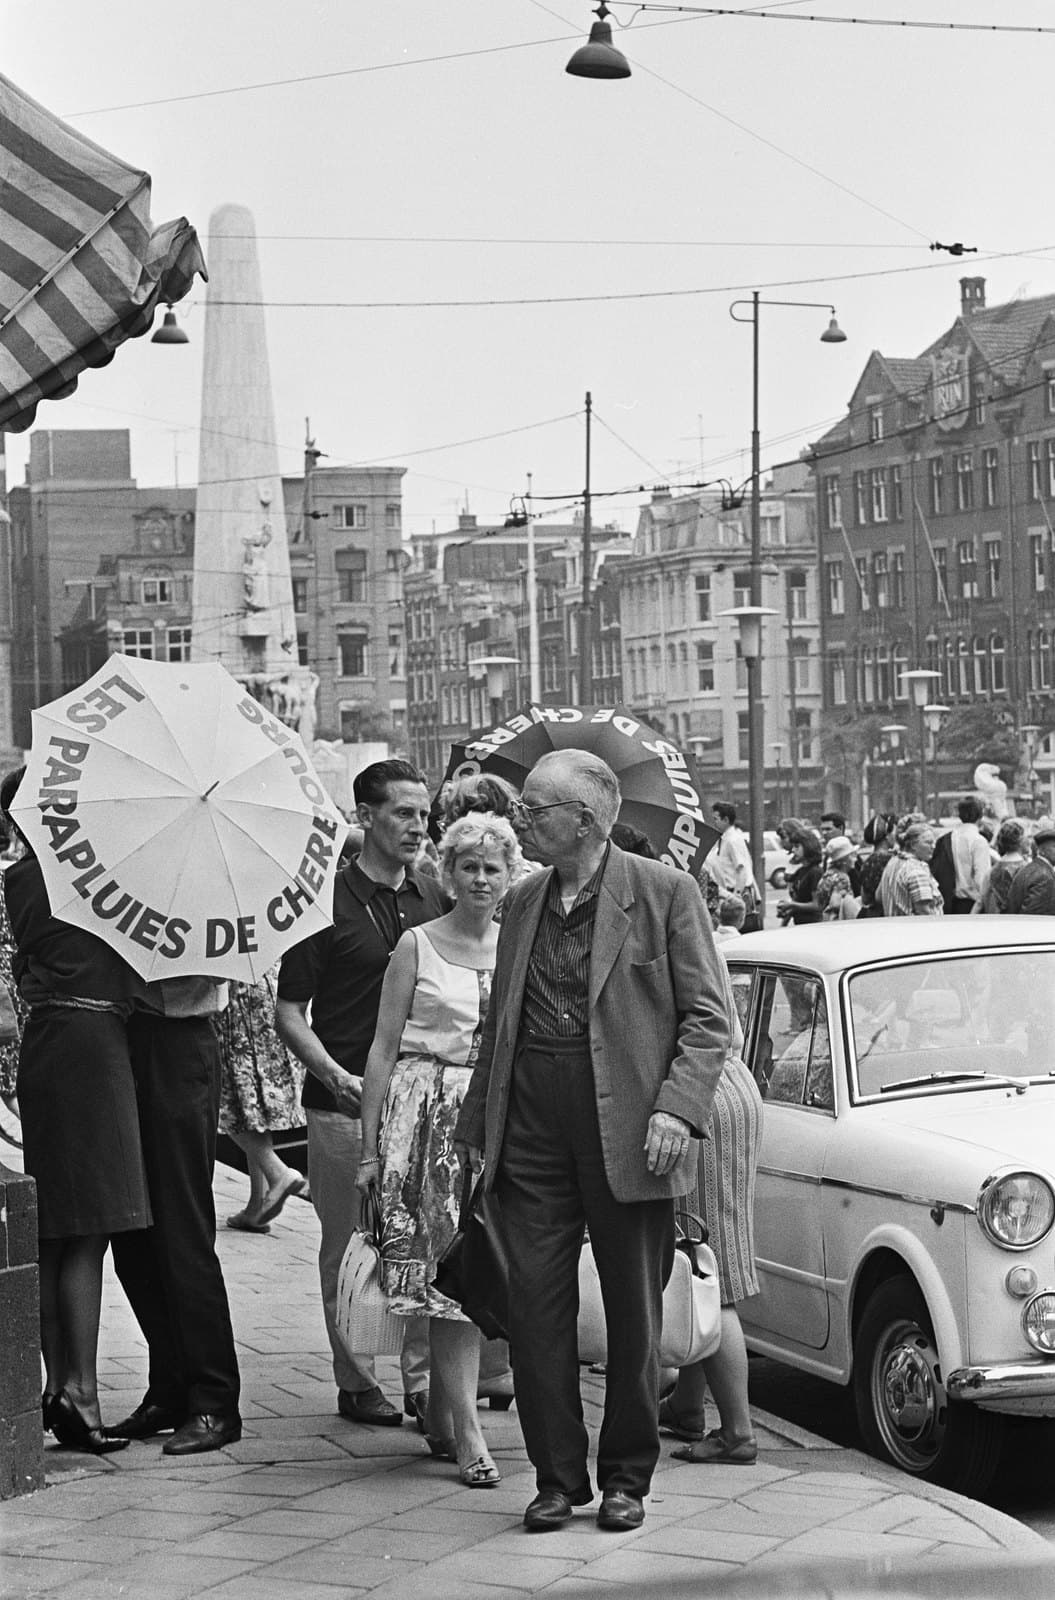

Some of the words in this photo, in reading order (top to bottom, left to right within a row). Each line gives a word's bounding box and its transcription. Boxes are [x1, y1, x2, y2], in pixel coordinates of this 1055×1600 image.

[66, 674, 145, 733] LES
[590, 708, 640, 737] DE
[236, 697, 338, 932] CHERBOURG
[37, 735, 192, 959] PARAPLUIES
[205, 915, 258, 958] DE
